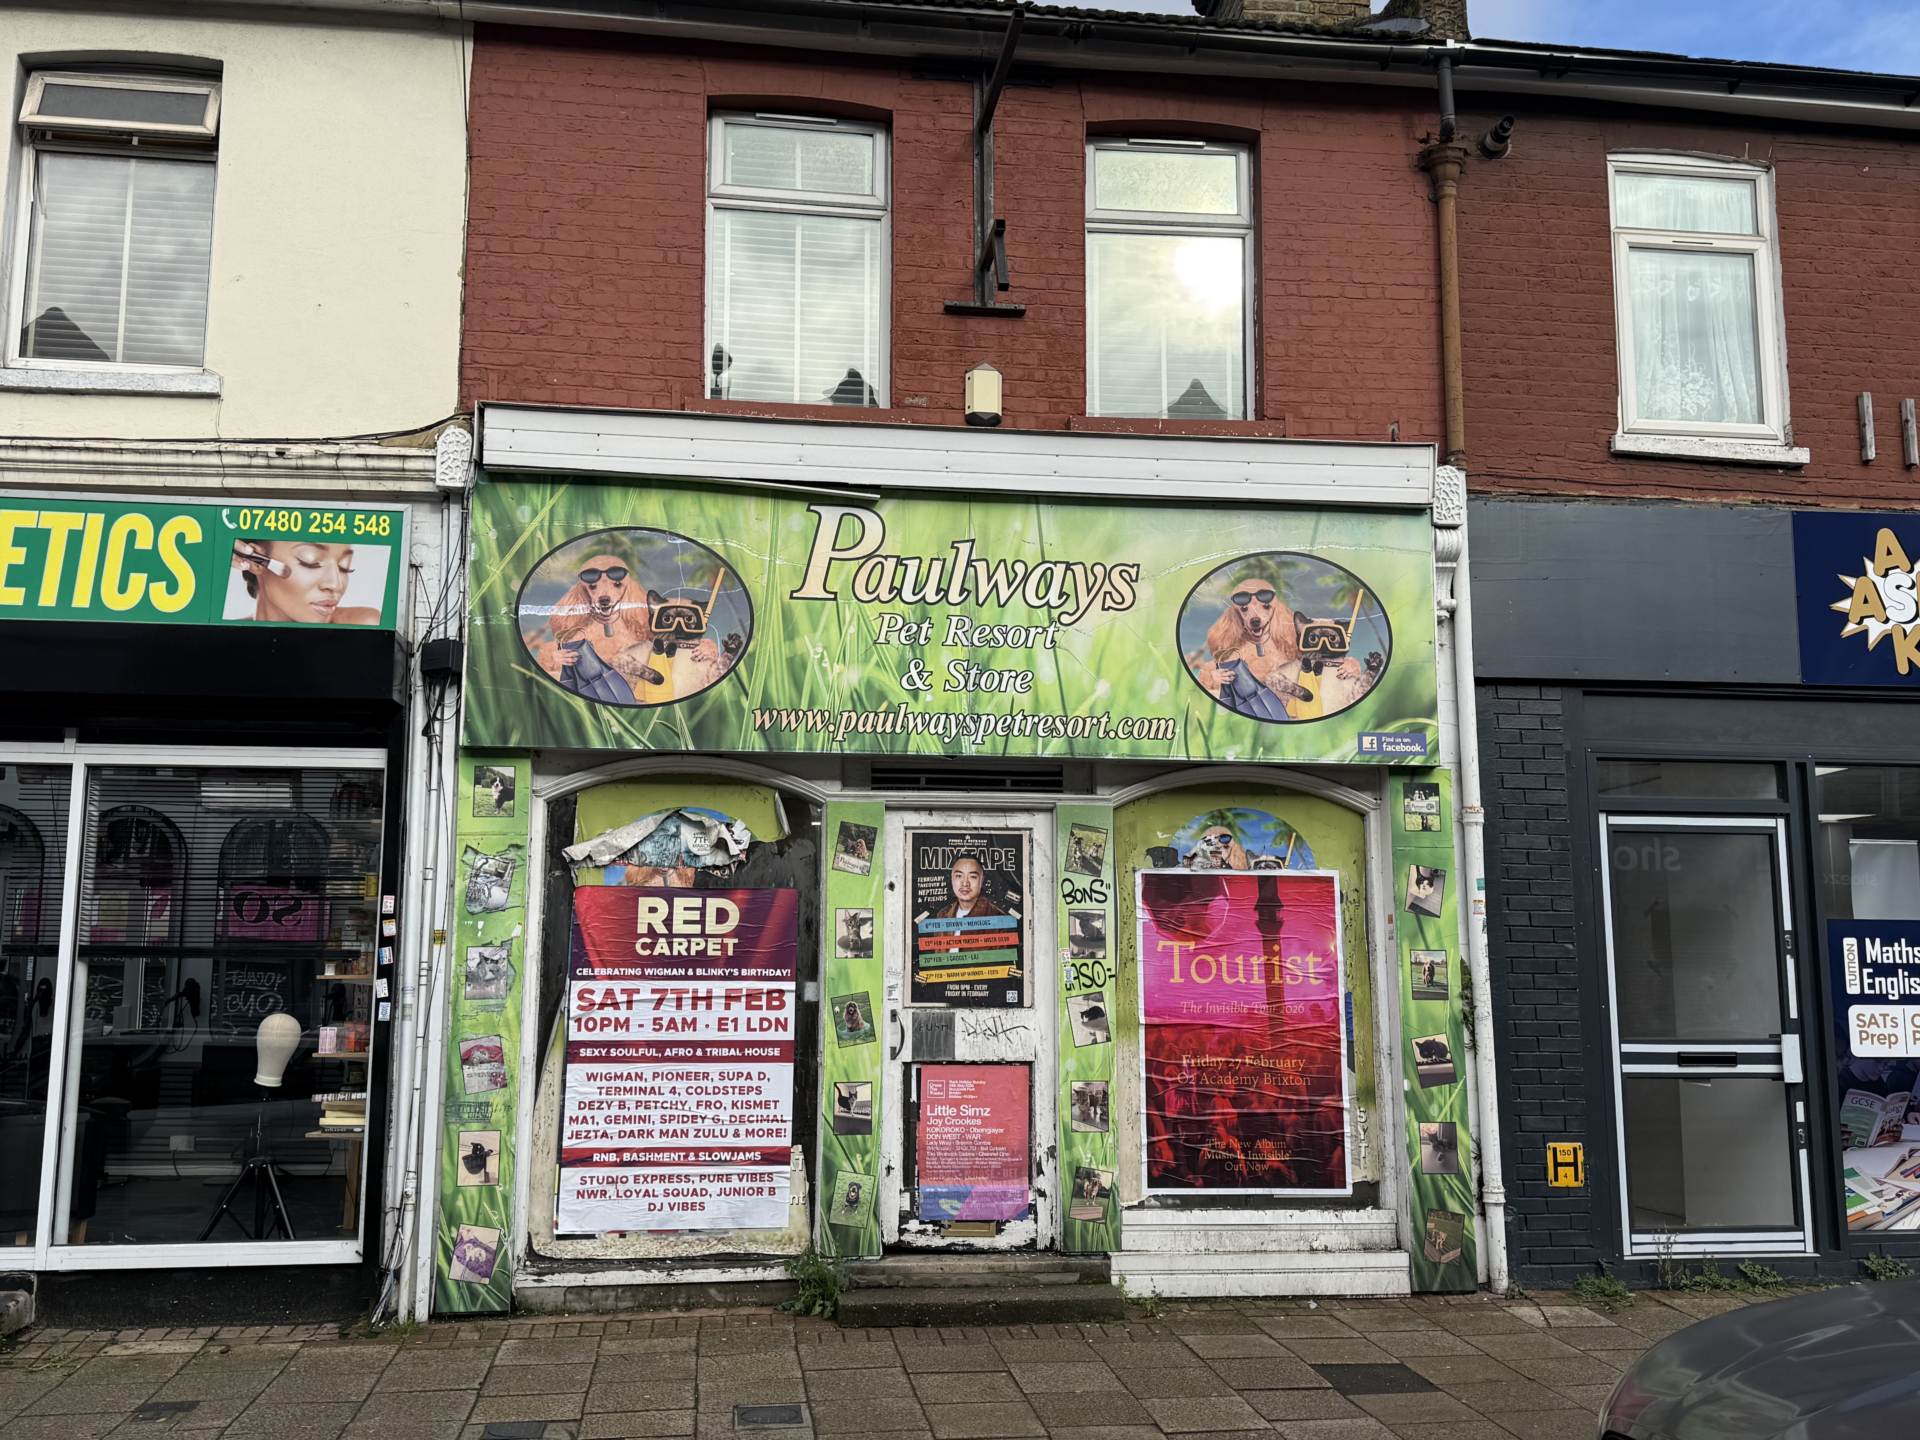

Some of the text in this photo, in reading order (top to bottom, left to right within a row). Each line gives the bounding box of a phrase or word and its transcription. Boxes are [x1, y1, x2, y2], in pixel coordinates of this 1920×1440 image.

[239, 508, 391, 537] 07480 254 548
[0, 509, 203, 614] ETICS
[790, 504, 1140, 625] Paulways
[875, 613, 1059, 650] Pet Resort
[900, 659, 1034, 693] & Store
[753, 703, 1176, 745] www.paulwayspetresort.com
[636, 896, 740, 935] RED
[635, 937, 738, 956] CARPET
[1157, 940, 1323, 985] Tourist
[1846, 943, 1858, 988] TUITION
[576, 968, 791, 977] CELEBRATING WIGMAN & BLINKY'S BIRTHDAY!
[576, 987, 787, 1011] SAT 7TH FEB
[1181, 1001, 1201, 1014] The
[1205, 1001, 1248, 1014] Invisible
[1281, 1003, 1305, 1014] 2026
[574, 1017, 630, 1032] 10PM
[652, 1016, 697, 1032] 5AM
[717, 1017, 738, 1032] E1
[746, 1017, 788, 1032] LDN
[1856, 1013, 1899, 1029] SATs
[1858, 1030, 1899, 1049] Prep
[580, 1048, 781, 1058] SEXY SOULFUL, AFRO & TRIBAL HOUSE
[1182, 1055, 1306, 1071] Friday 27 February
[586, 1071, 771, 1083] WIGMAN, PIONEER, SUPA D,
[1177, 1072, 1311, 1089] O2 Academy Brixton
[597, 1086, 763, 1097] TERMINAL 4, COLDSTEPS
[578, 1100, 780, 1112] DEZY B, PETCHY, FRO, KISMET
[1851, 1096, 1876, 1108] GCSE
[927, 1104, 991, 1116] Little Simz
[604, 1115, 655, 1126] GEMINI,
[660, 1115, 707, 1124] SPIDEY
[728, 1114, 787, 1124] DECIMAL
[927, 1117, 982, 1126] Joy Crookes
[568, 1128, 787, 1141] JEZTA, DARK MAN ZULU & MORE!
[1206, 1138, 1287, 1149] The New Album
[593, 1151, 762, 1163] RNB, BASHMENT & SLOWJAMS
[1552, 1146, 1579, 1182] H
[1224, 1162, 1270, 1171] Out Now
[580, 1173, 774, 1185] STUDIO EXPRESS, PURE VIBES
[576, 1187, 777, 1201] NWR, LOYAL SQUAD, JUNIOR B
[648, 1201, 706, 1212] DJ VIBES
